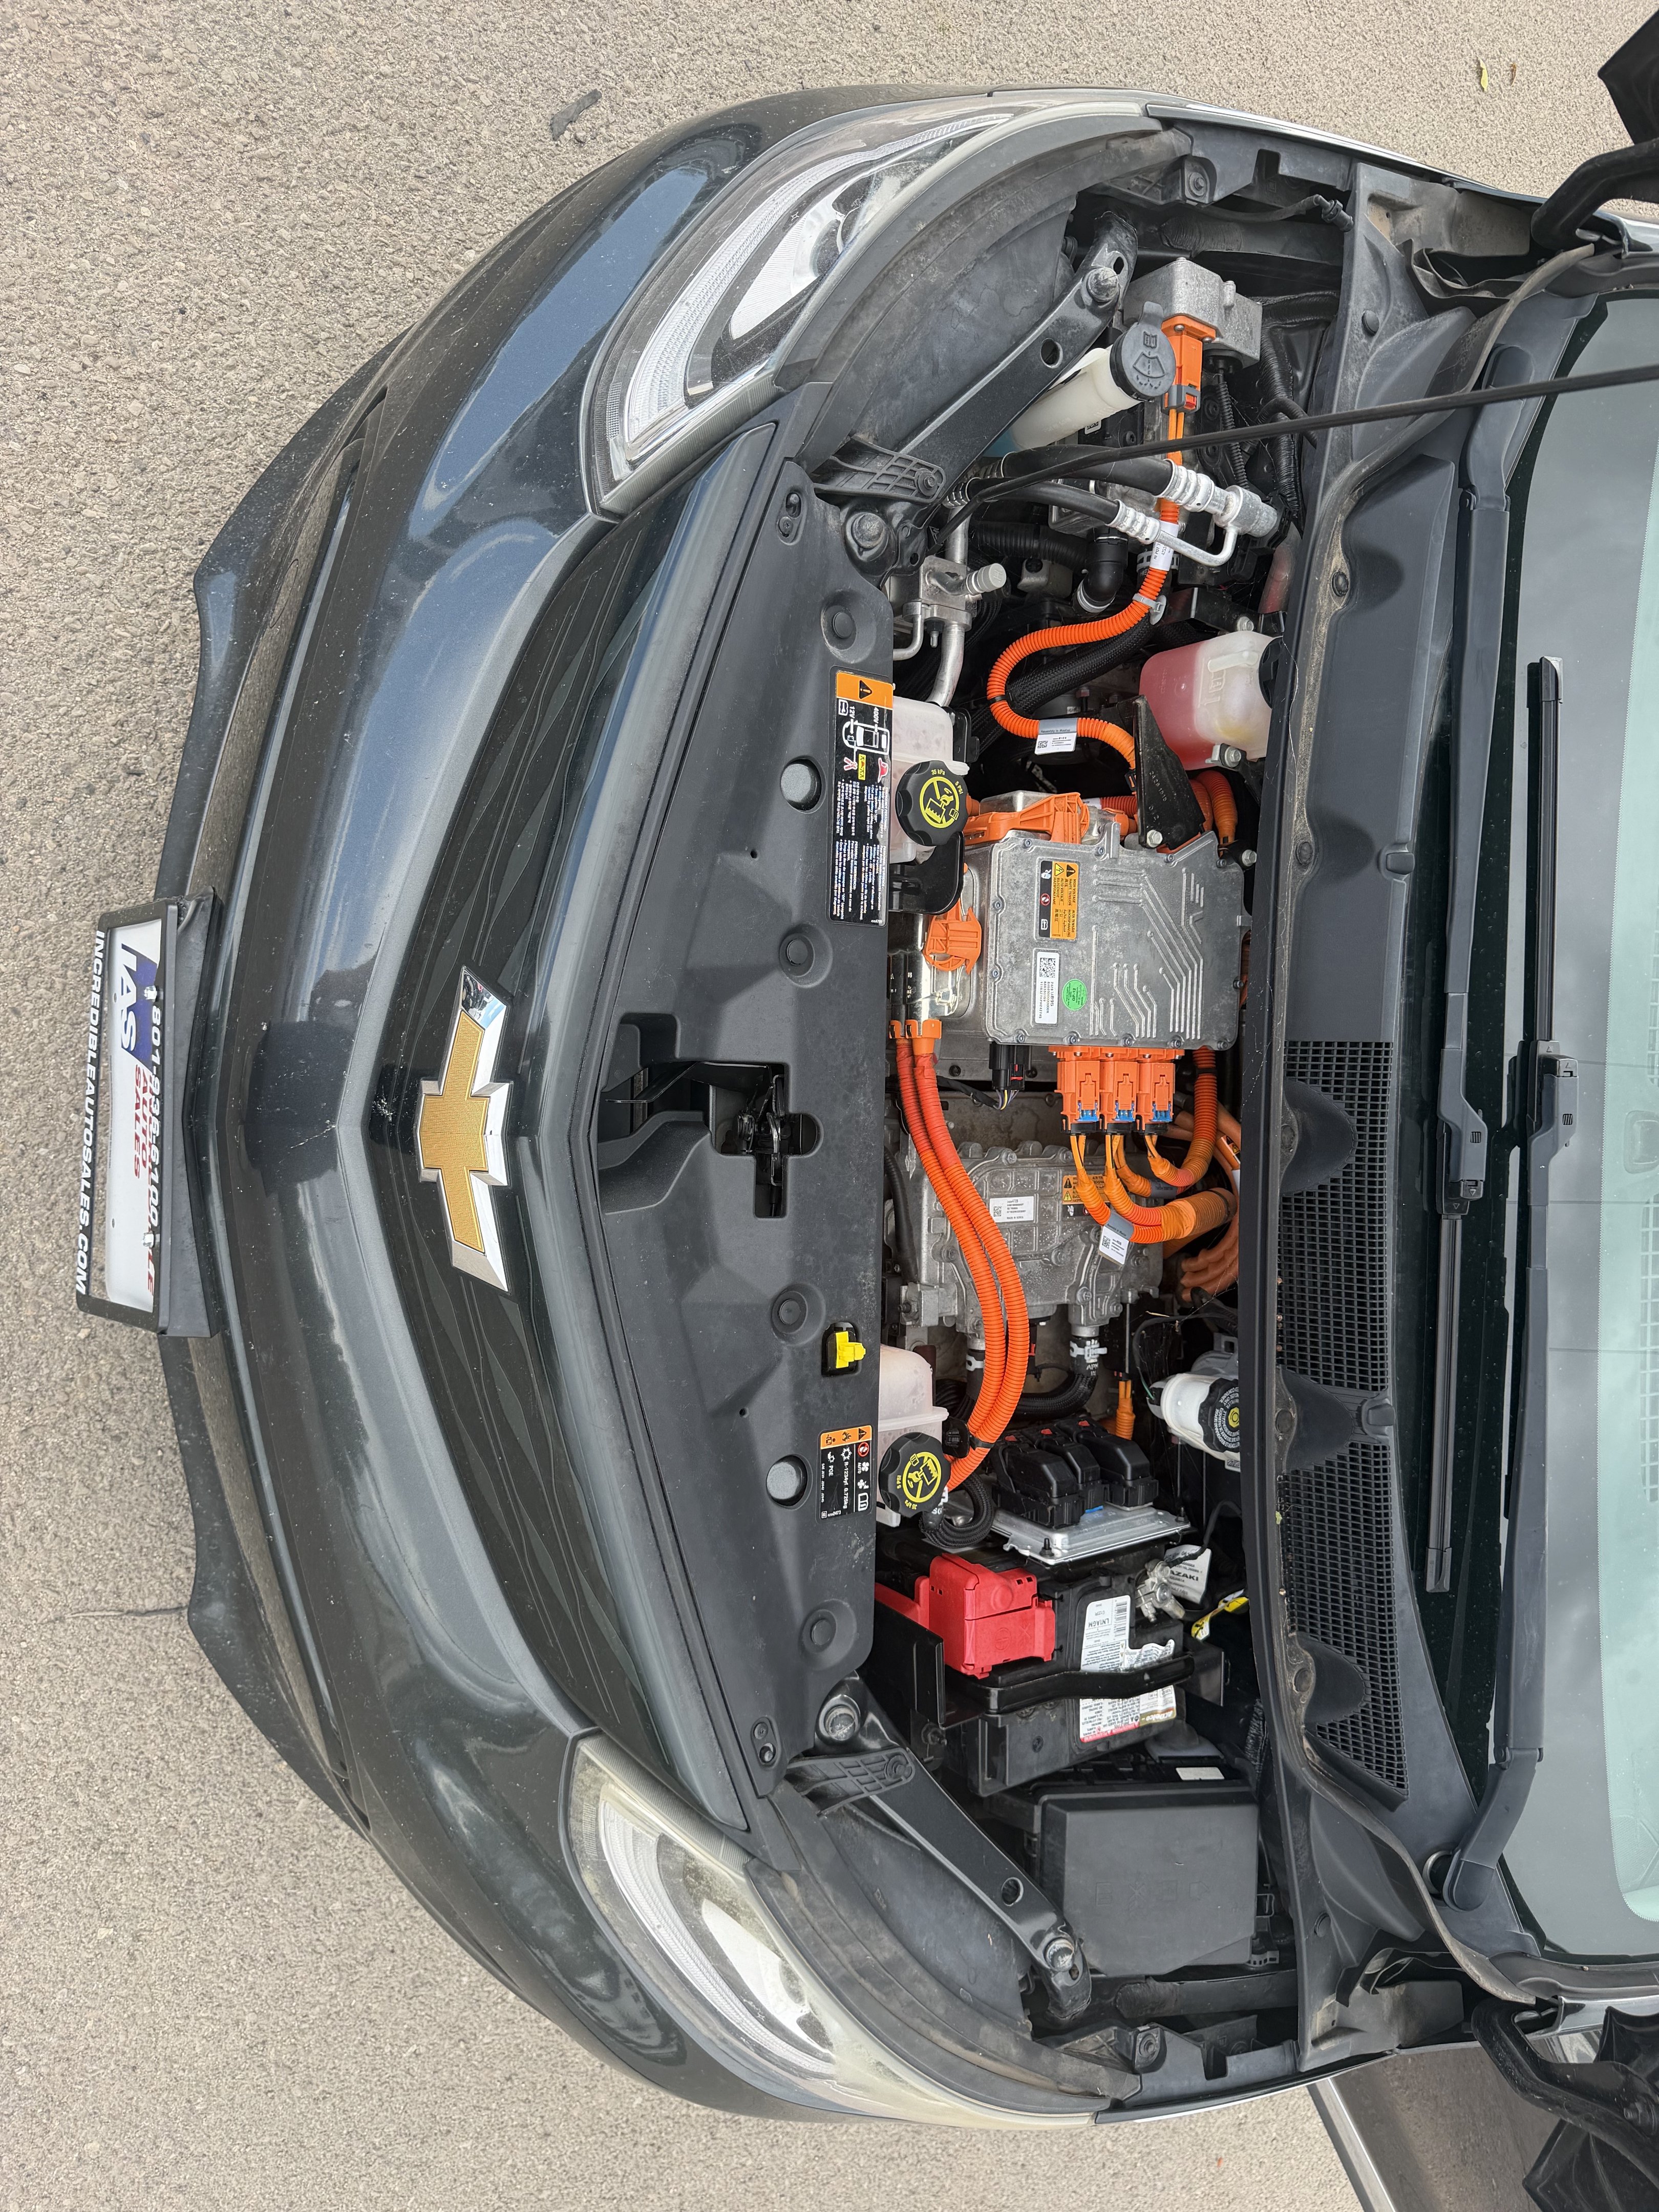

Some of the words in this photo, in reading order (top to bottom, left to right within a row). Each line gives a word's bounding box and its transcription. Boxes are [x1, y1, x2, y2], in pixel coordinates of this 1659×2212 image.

[120, 947, 137, 1051] IAS
[76, 930, 105, 1295] INCREDIBLEAUTOSALES.COM
[150, 1005, 161, 1226] 801-936-6100
